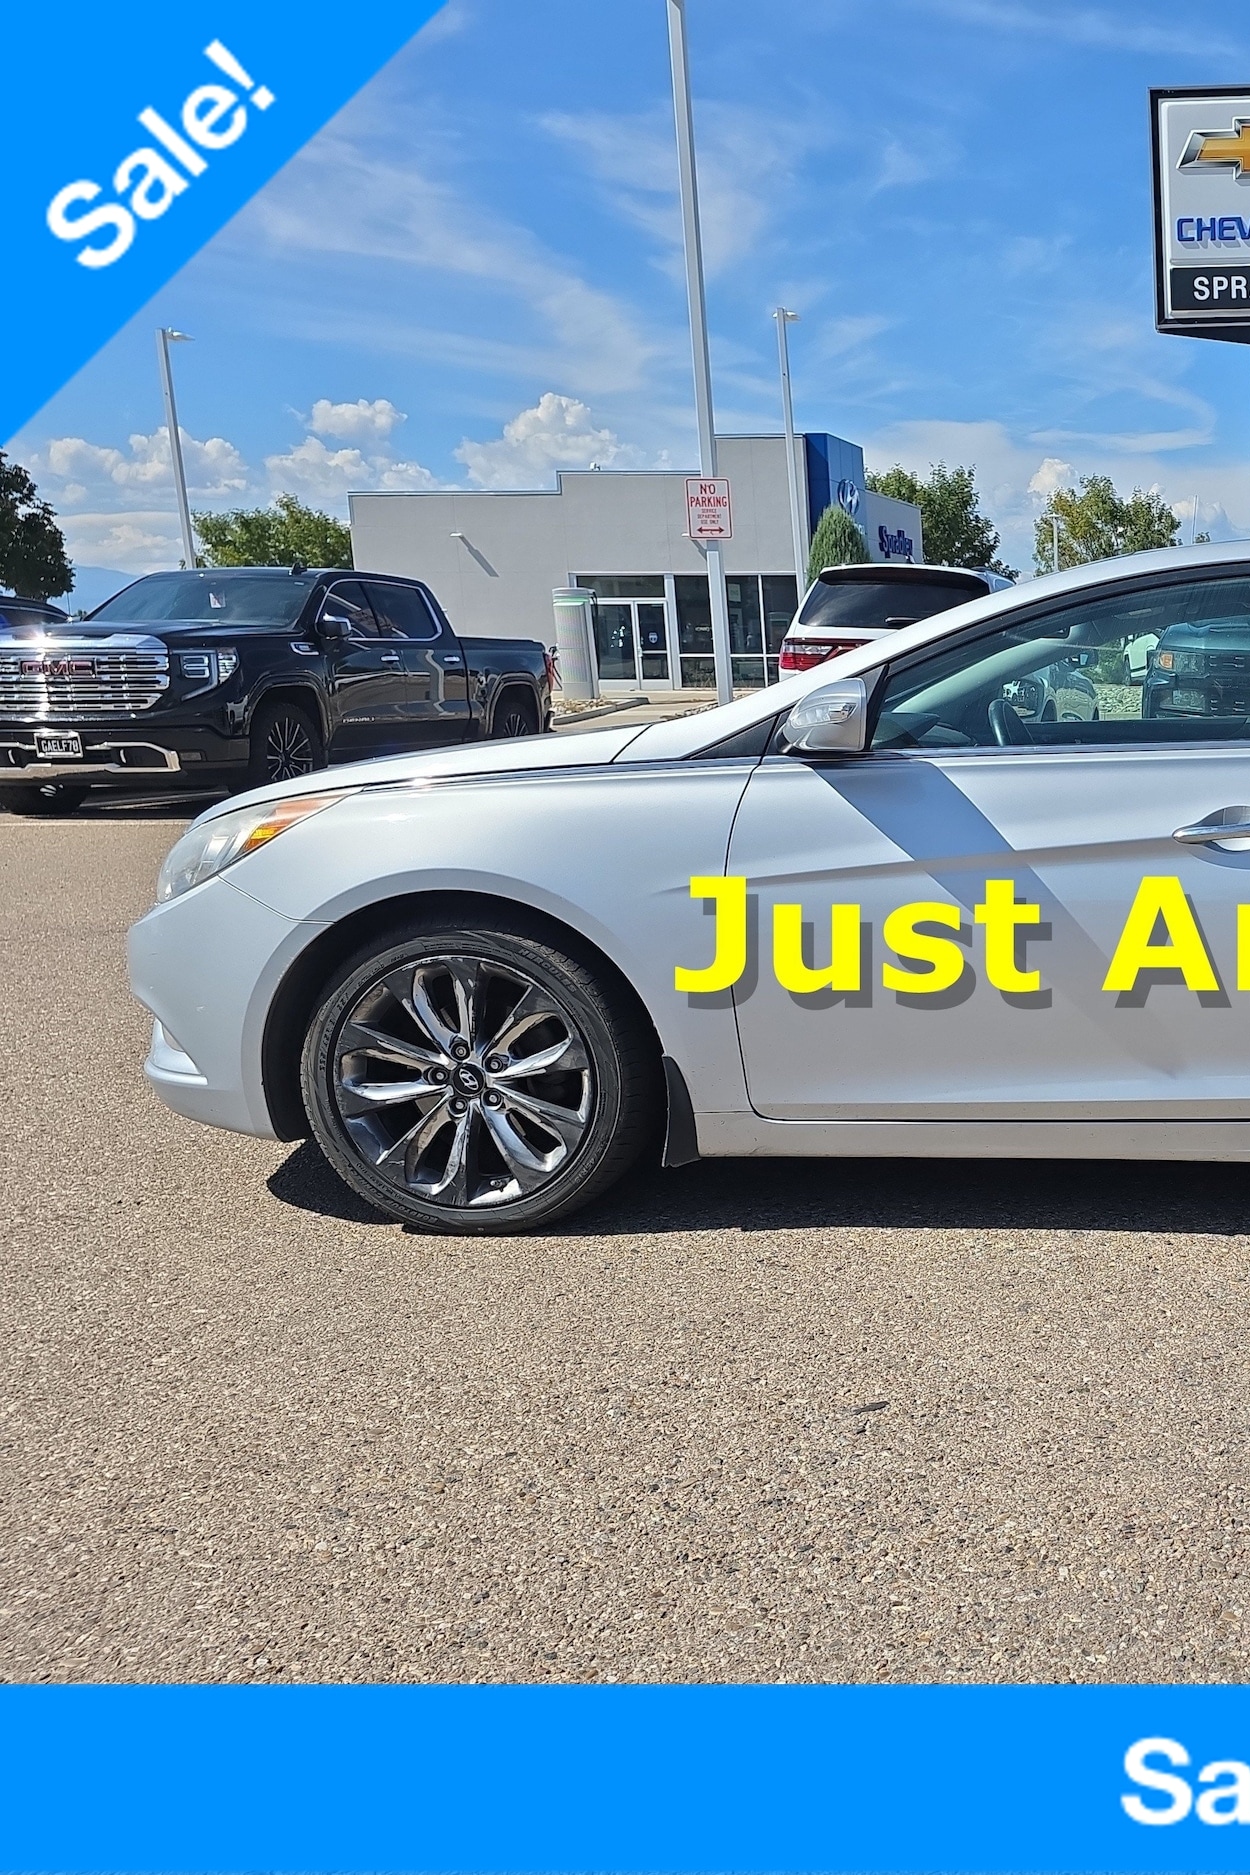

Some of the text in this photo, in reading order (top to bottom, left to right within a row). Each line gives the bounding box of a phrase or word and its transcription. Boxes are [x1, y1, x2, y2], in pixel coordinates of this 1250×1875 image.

[700, 483, 716, 495] NO
[690, 496, 728, 508] PARKING
[21, 660, 94, 676] GMC
[518, 948, 577, 993] HERCULES
